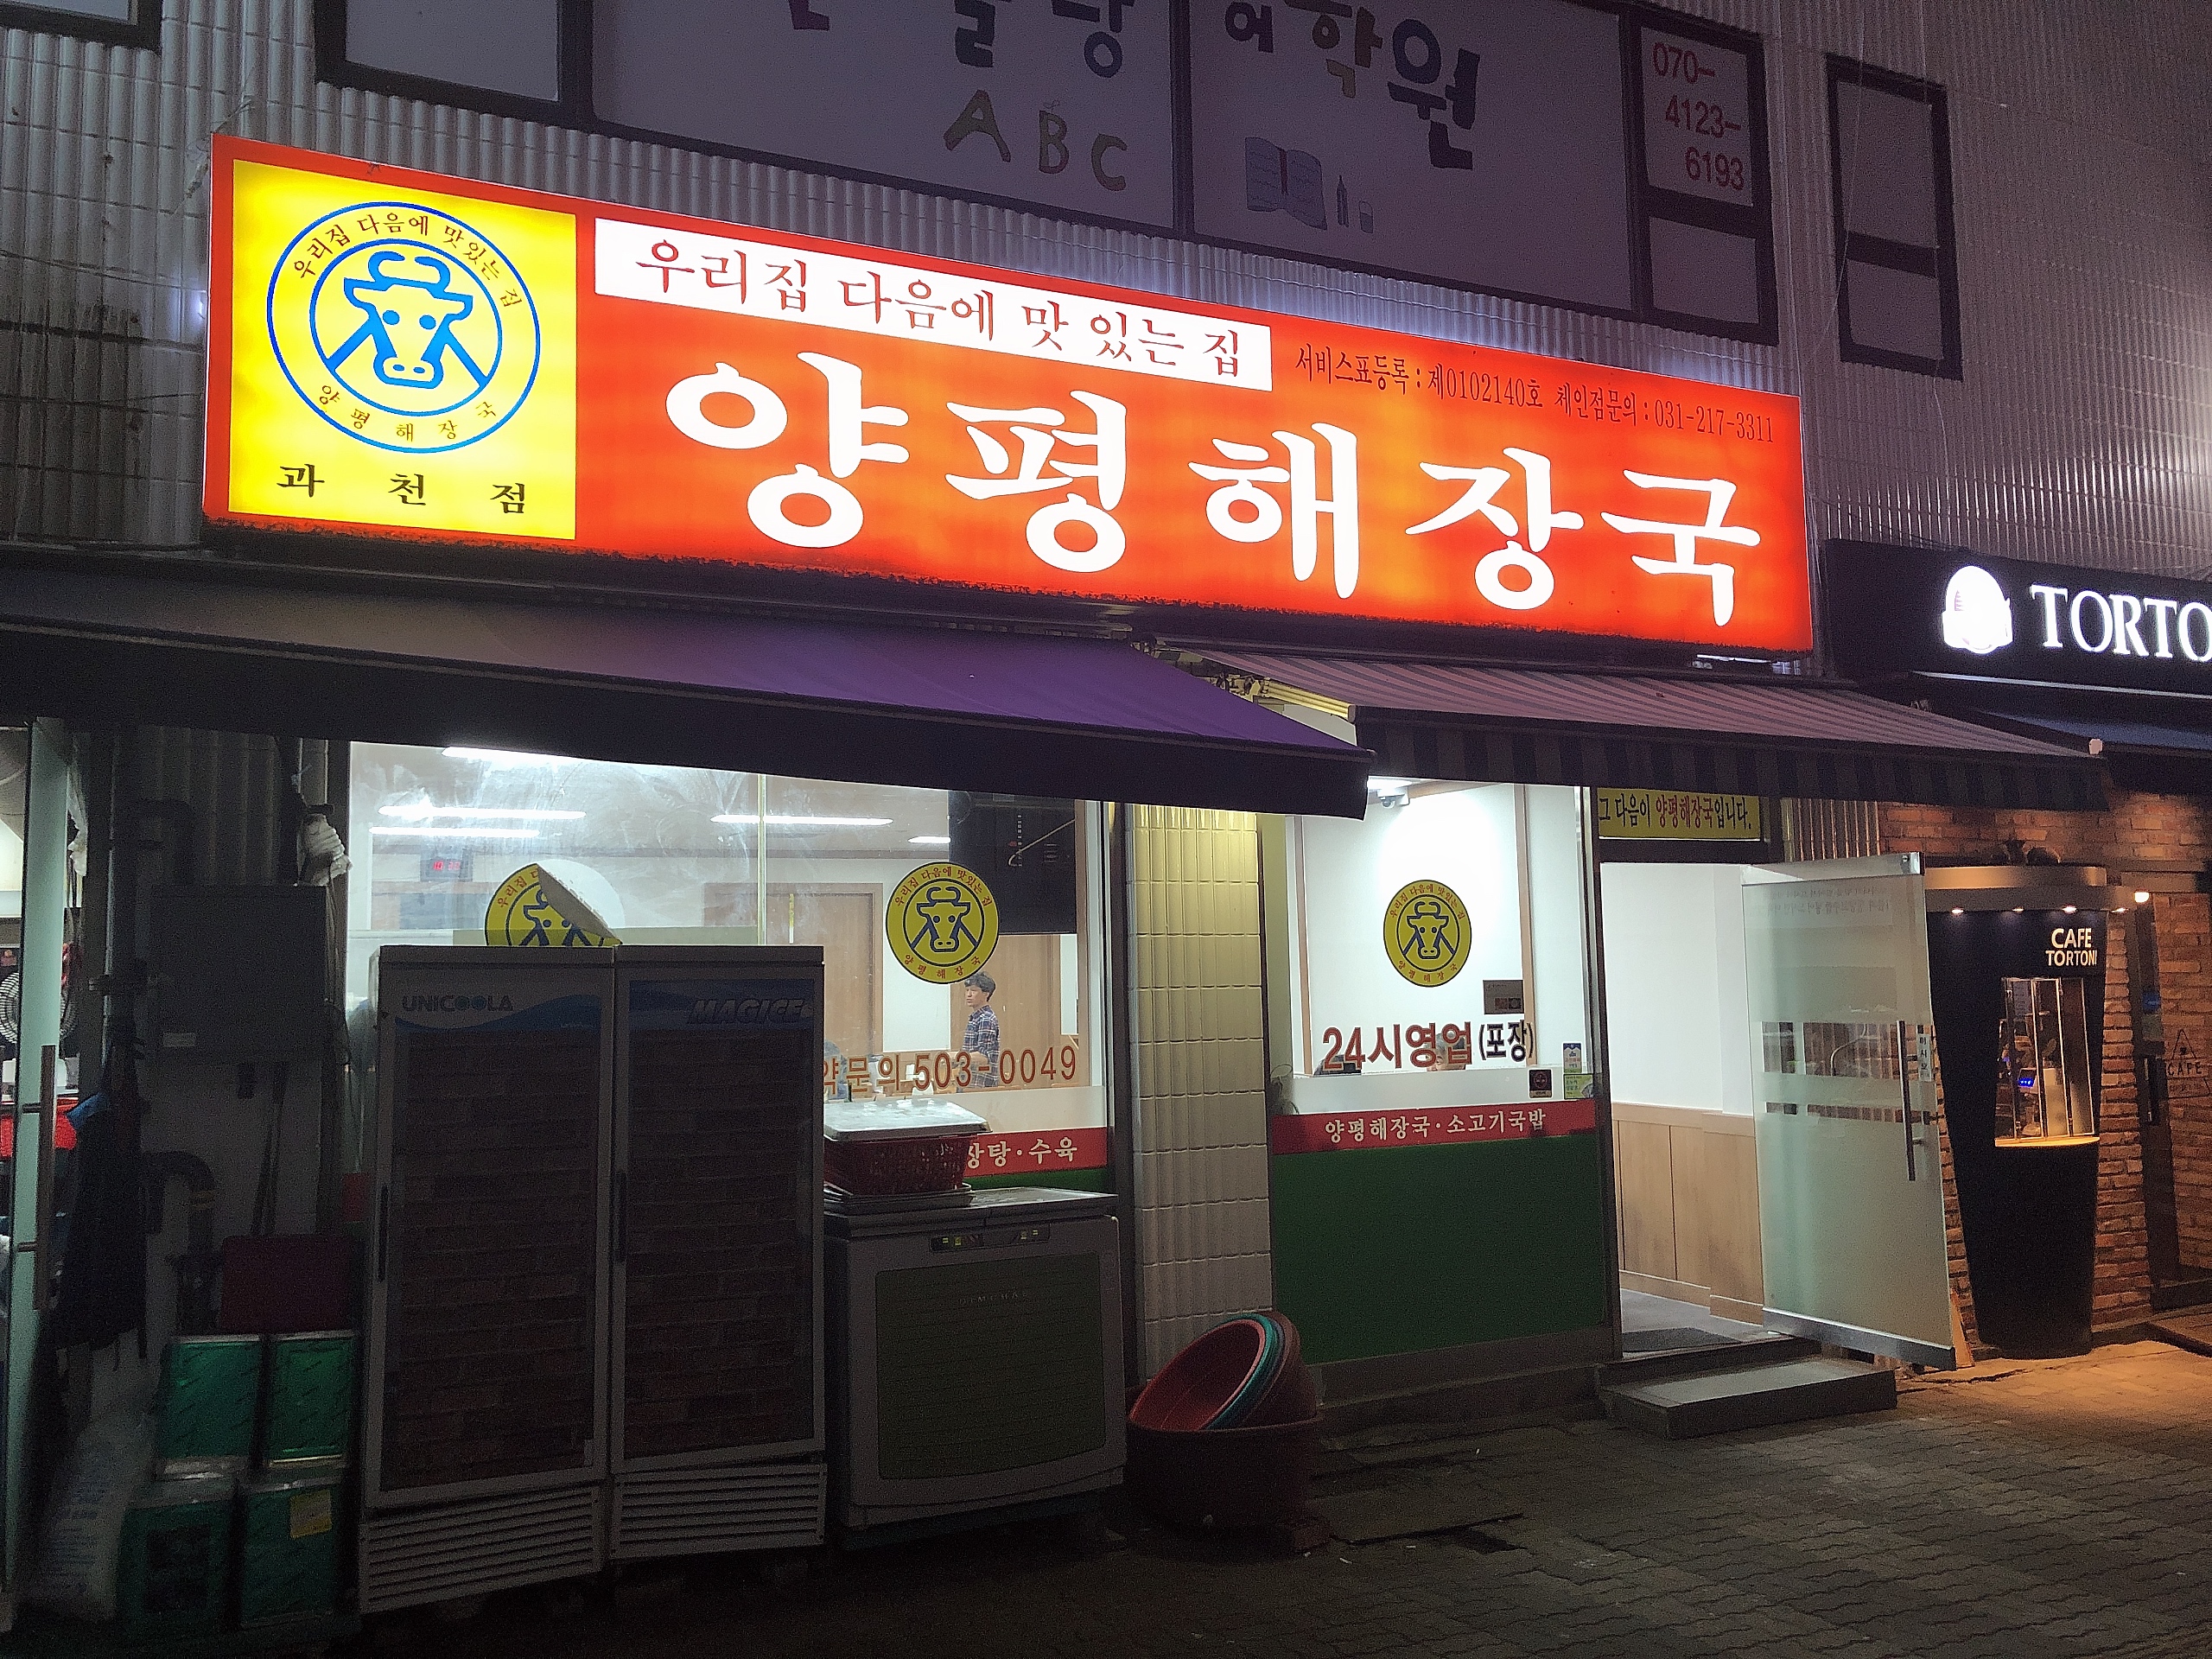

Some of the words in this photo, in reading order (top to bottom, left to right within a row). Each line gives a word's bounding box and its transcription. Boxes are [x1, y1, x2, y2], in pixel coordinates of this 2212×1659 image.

[1665, 94, 1741, 138] 4123-
[1686, 146, 1745, 191] 6193
[294, 224, 351, 279] 우리집
[357, 213, 429, 236] 다음에
[443, 226, 500, 281] 맛있는
[500, 289, 522, 308] 집
[635, 239, 810, 313] 우리집
[837, 272, 995, 342] 다음에
[1427, 363, 1543, 408] 제0102140호
[1655, 399, 1774, 442] 031-217-3311
[665, 352, 1762, 627] 양평해장국
[1599, 798, 1611, 820] 그
[1614, 792, 1650, 828] 다음이
[1656, 793, 1751, 830] 양평해장국입니다.
[498, 875, 527, 908] 우리집
[894, 877, 919, 906] 우리집
[920, 866, 952, 880] 다음에
[957, 869, 982, 894] 맛있는
[1409, 883, 1434, 896] 다음에
[2044, 950, 2098, 967] TORTONI
[2051, 927, 2093, 949] CAFE
[1322, 1021, 1473, 1071] 24시영업
[1478, 1020, 1535, 1062] (포장)
[913, 1046, 1077, 1090] 503-0049
